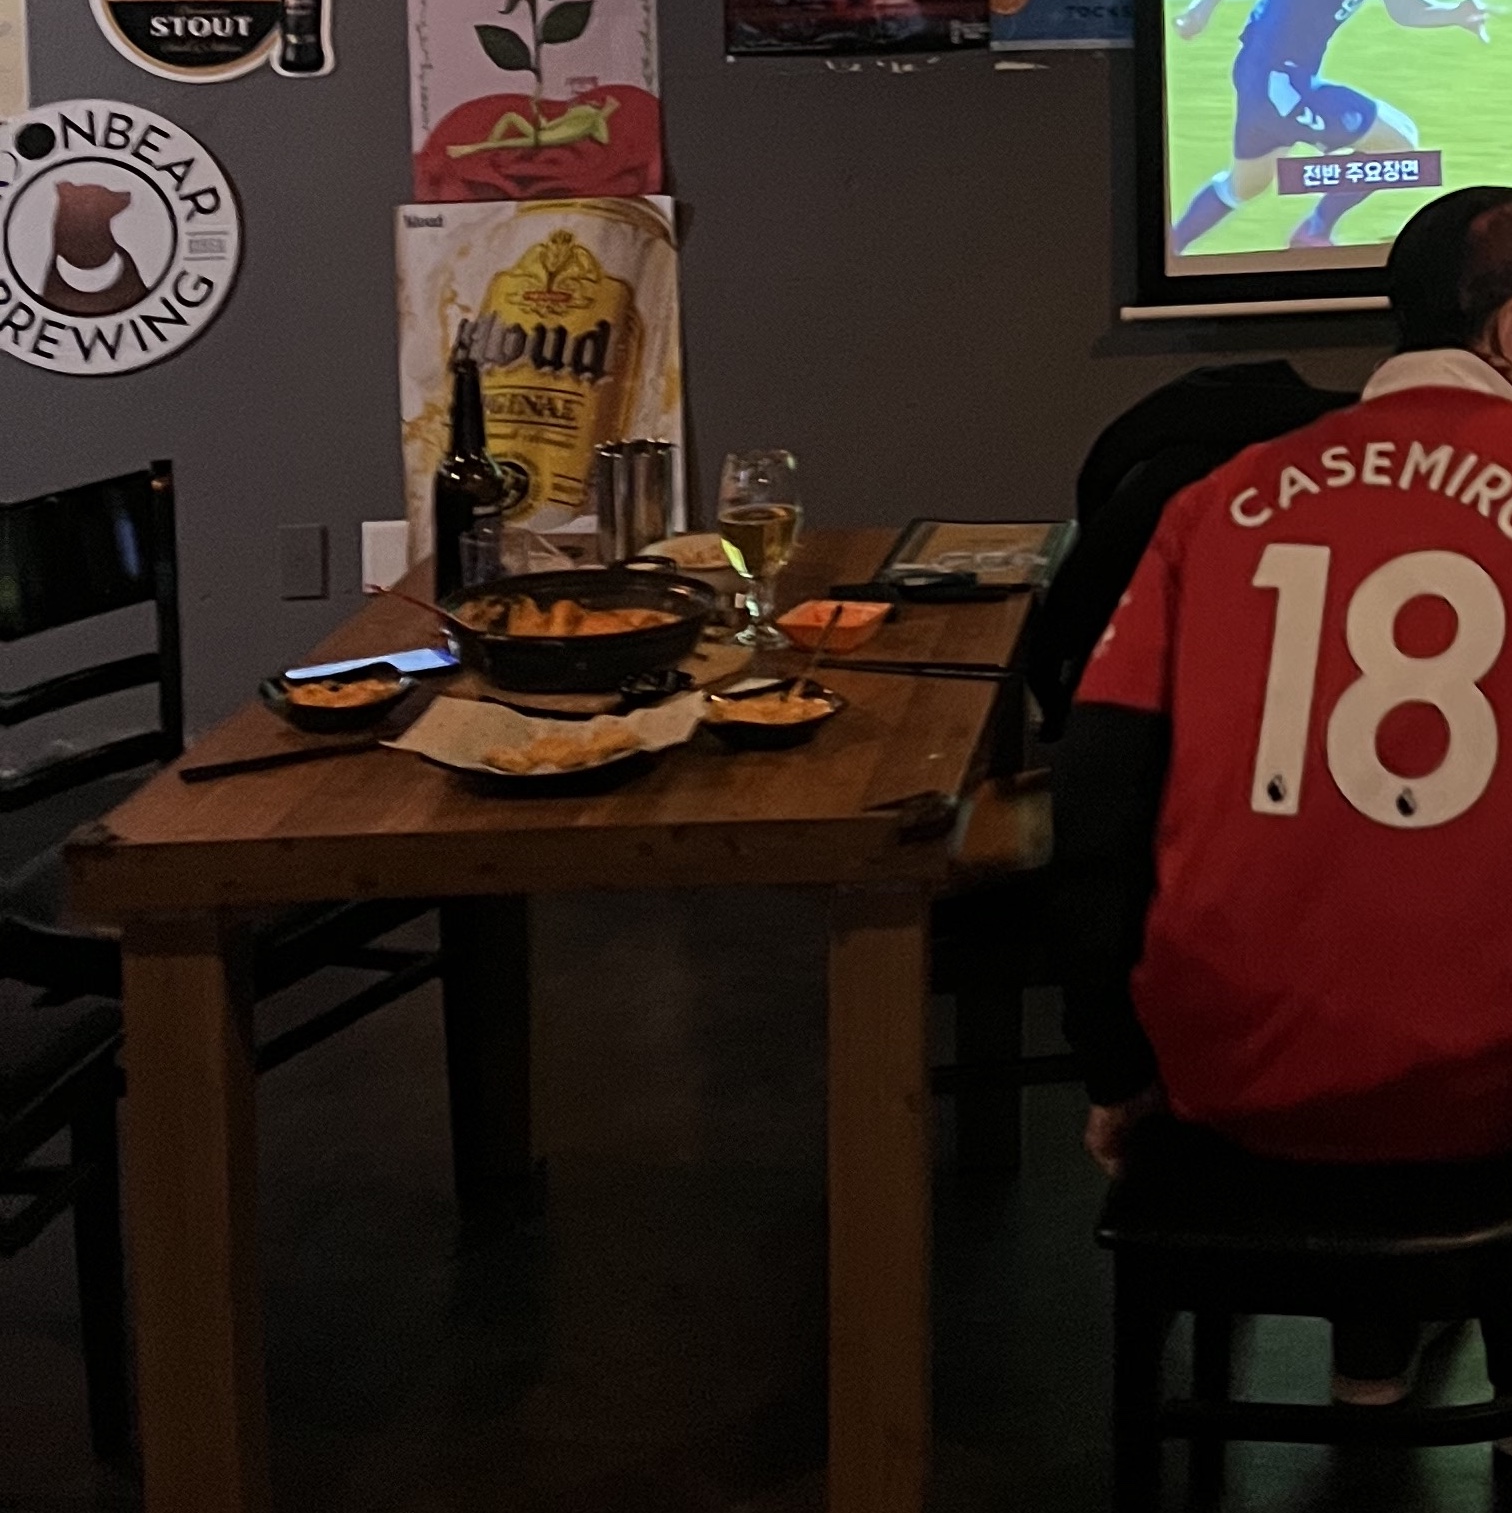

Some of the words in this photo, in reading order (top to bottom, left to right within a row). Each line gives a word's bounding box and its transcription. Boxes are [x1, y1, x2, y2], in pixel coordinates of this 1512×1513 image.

[150, 13, 254, 38] STOUT
[1302, 163, 1342, 187] 전반
[1345, 159, 1420, 184] 주요장면
[1250, 542, 1507, 830] 18
